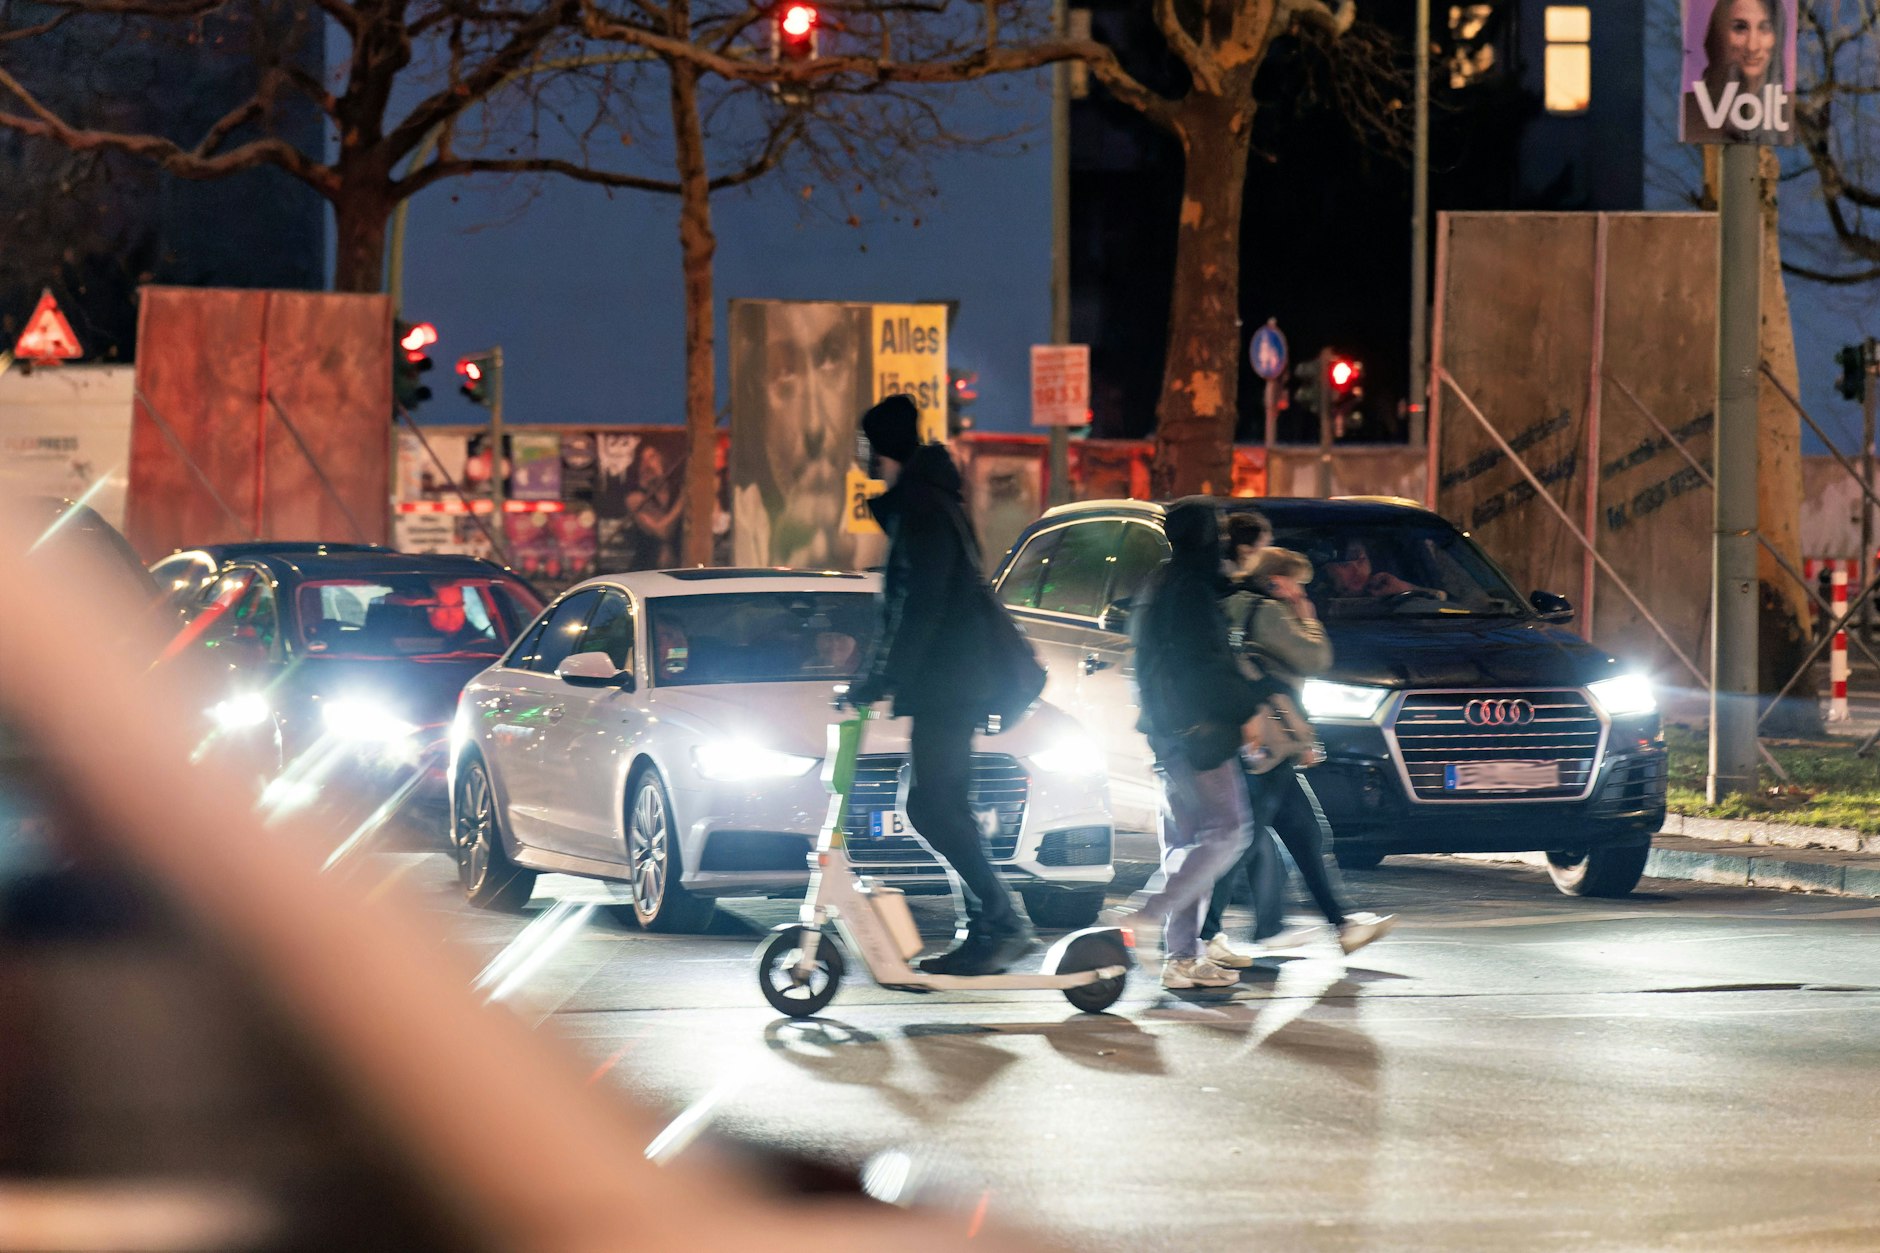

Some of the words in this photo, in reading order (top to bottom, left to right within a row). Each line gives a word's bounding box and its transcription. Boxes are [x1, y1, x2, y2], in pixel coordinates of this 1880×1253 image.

[1692, 81, 1789, 132] Volt
[880, 317, 940, 354] Alles
[892, 813, 904, 834] B
